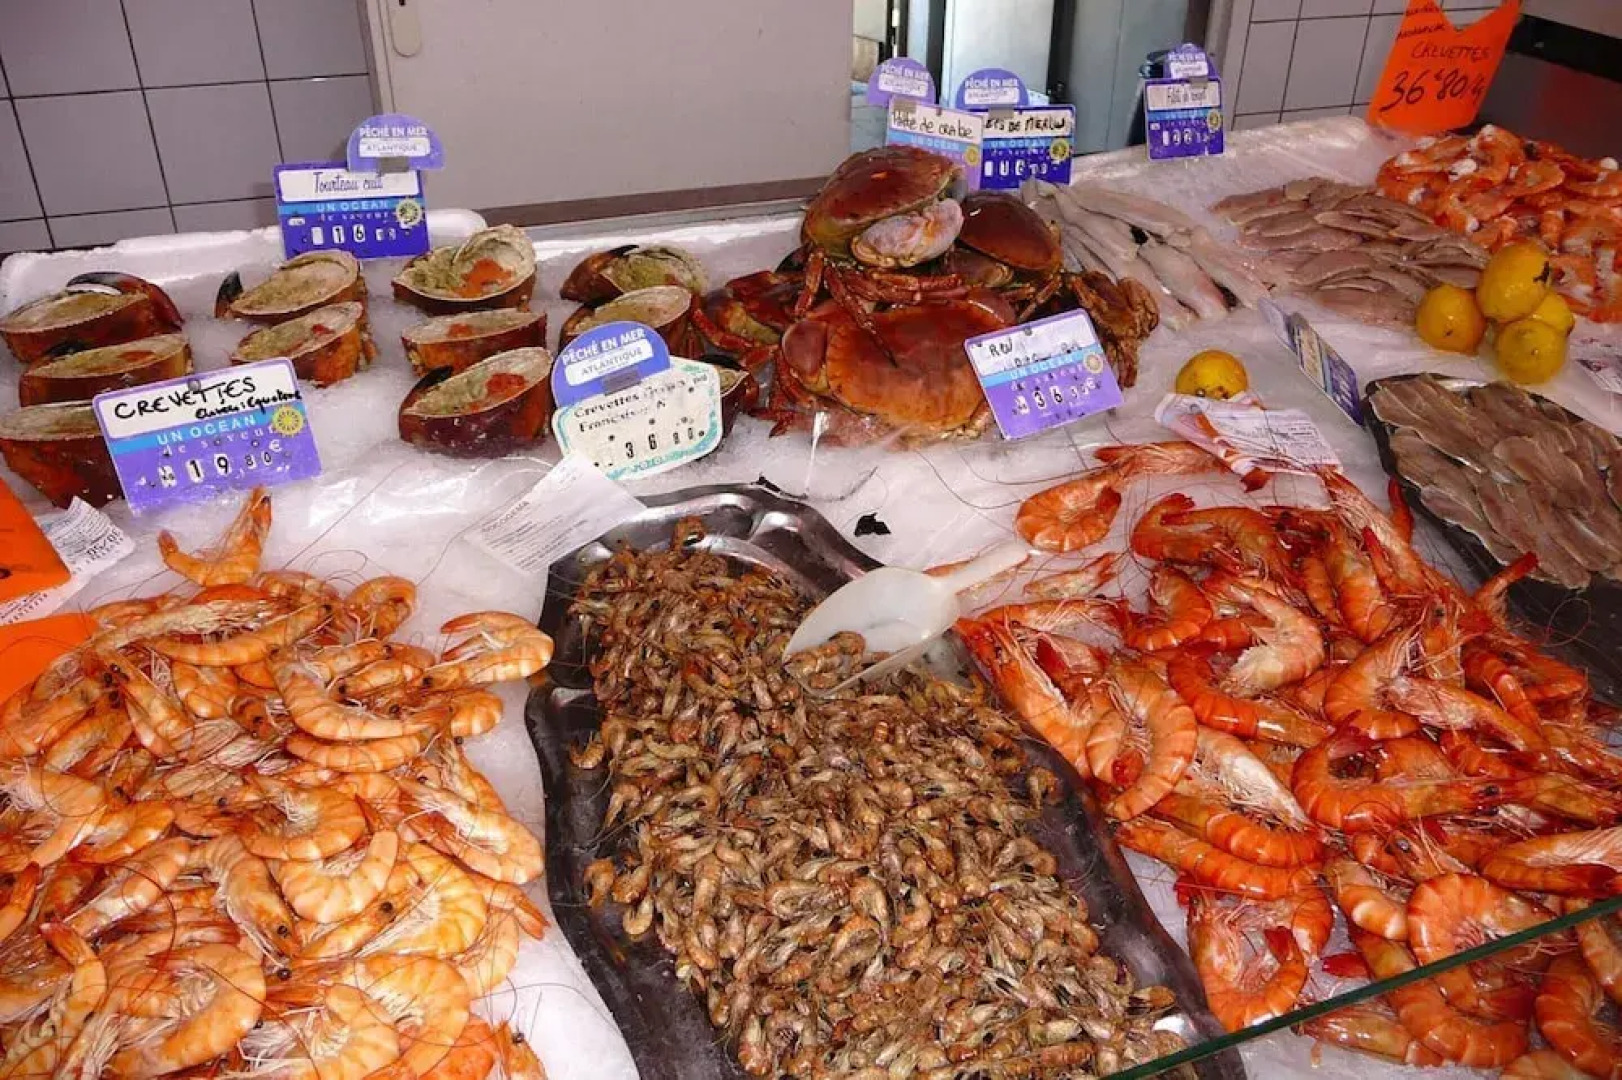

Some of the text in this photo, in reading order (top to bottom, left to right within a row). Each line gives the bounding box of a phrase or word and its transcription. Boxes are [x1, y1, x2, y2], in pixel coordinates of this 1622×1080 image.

[990, 77, 1001, 87] EN
[392, 127, 405, 137] EN
[407, 126, 428, 137] MER
[316, 200, 389, 212] UN OCEAN
[562, 328, 645, 366] PÊCHÉ EN MER
[581, 347, 643, 376] ATLANTIQUE
[114, 376, 256, 420] CREVETTES
[573, 392, 640, 418] Crevettes
[157, 415, 257, 445] UN OCEAN
